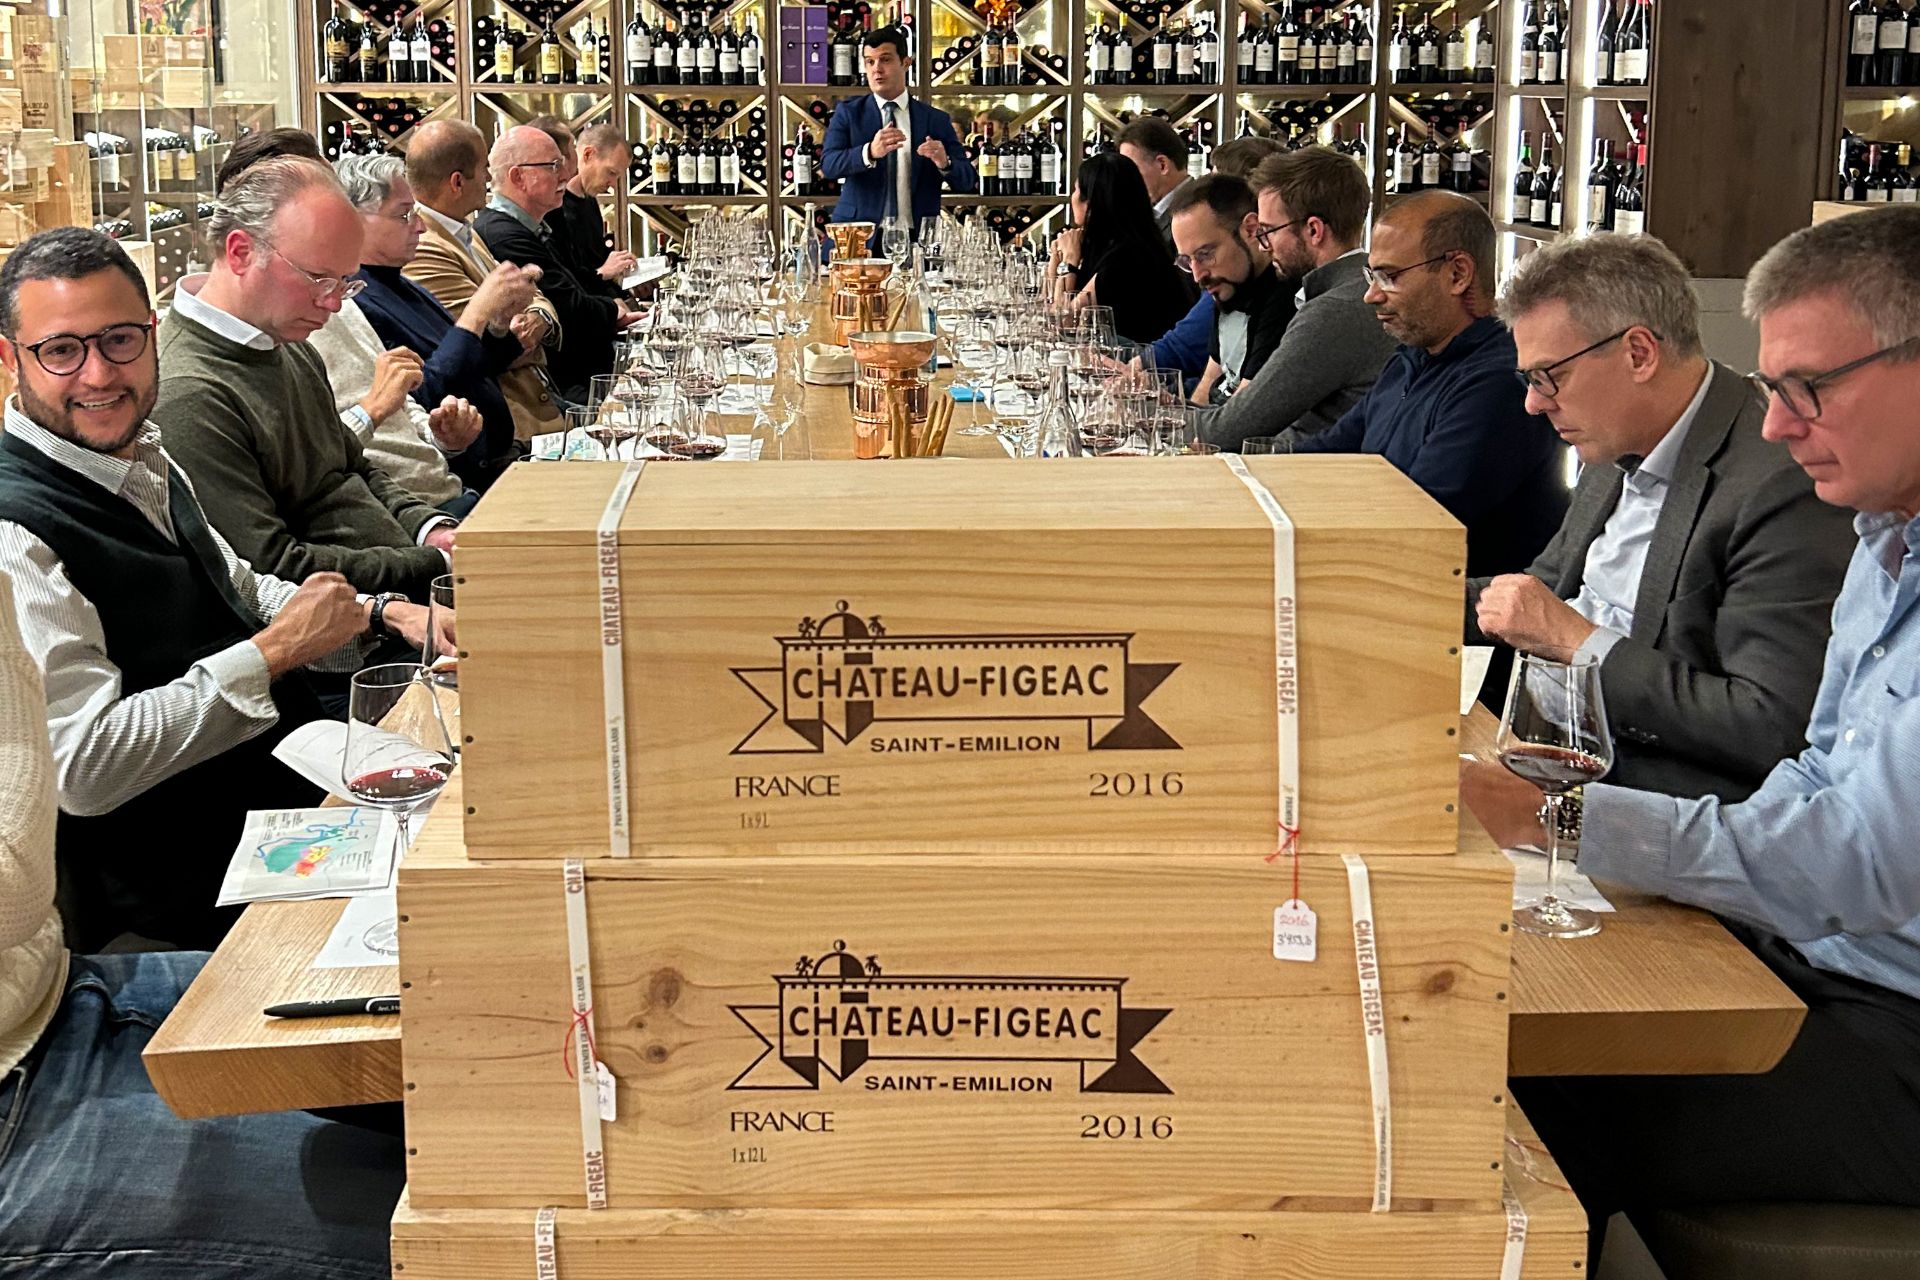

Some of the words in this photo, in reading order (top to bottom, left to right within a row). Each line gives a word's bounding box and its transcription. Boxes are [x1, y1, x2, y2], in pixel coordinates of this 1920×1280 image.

[792, 665, 1110, 699] CHATEAU-FIGEAC
[870, 735, 1060, 753] SAINT-EMILION
[735, 775, 840, 798] FRANCE
[1089, 771, 1185, 797] 2016
[788, 1006, 1102, 1038] CHATEAU-FIGEAC
[864, 1075, 1053, 1092] SAINT-EMILION
[730, 1111, 834, 1132] FRANCE
[1080, 1114, 1173, 1139] 2016
